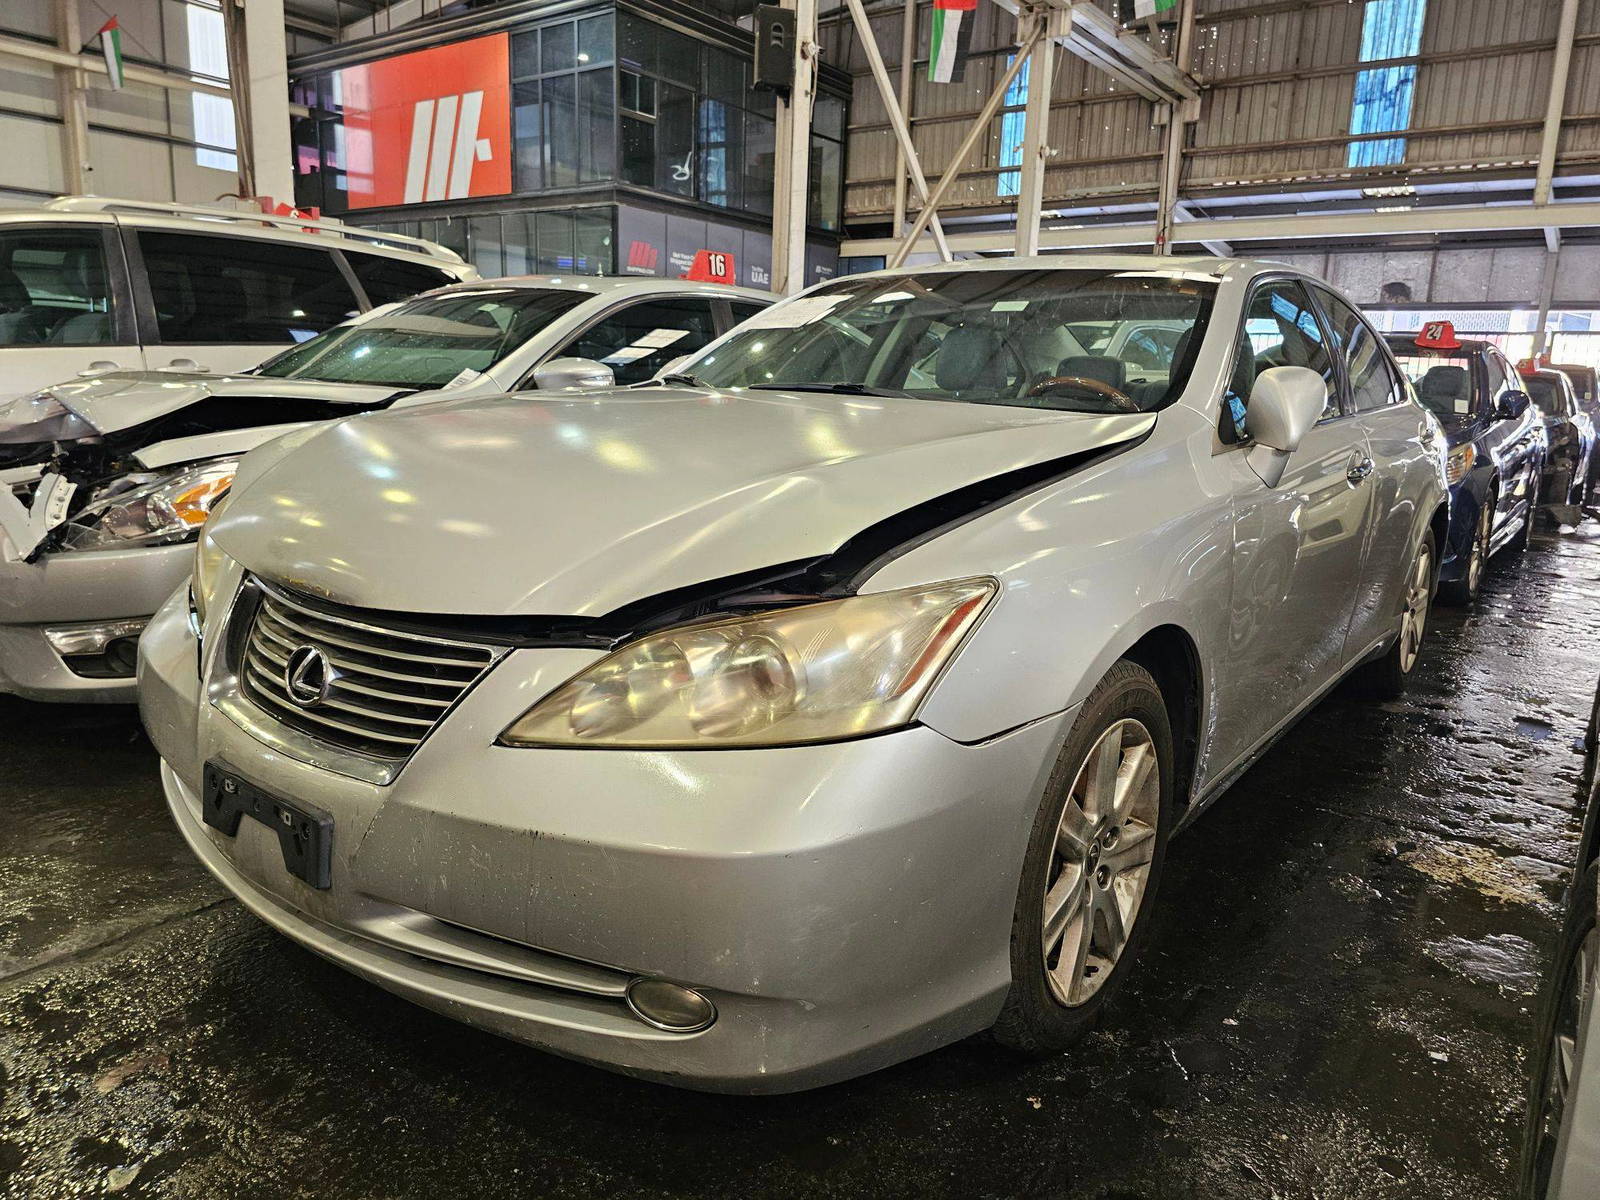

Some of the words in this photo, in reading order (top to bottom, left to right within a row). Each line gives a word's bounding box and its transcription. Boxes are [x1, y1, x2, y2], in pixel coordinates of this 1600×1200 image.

[709, 253, 725, 277] 16
[751, 271, 769, 285] UAE
[1426, 324, 1443, 341] 24
